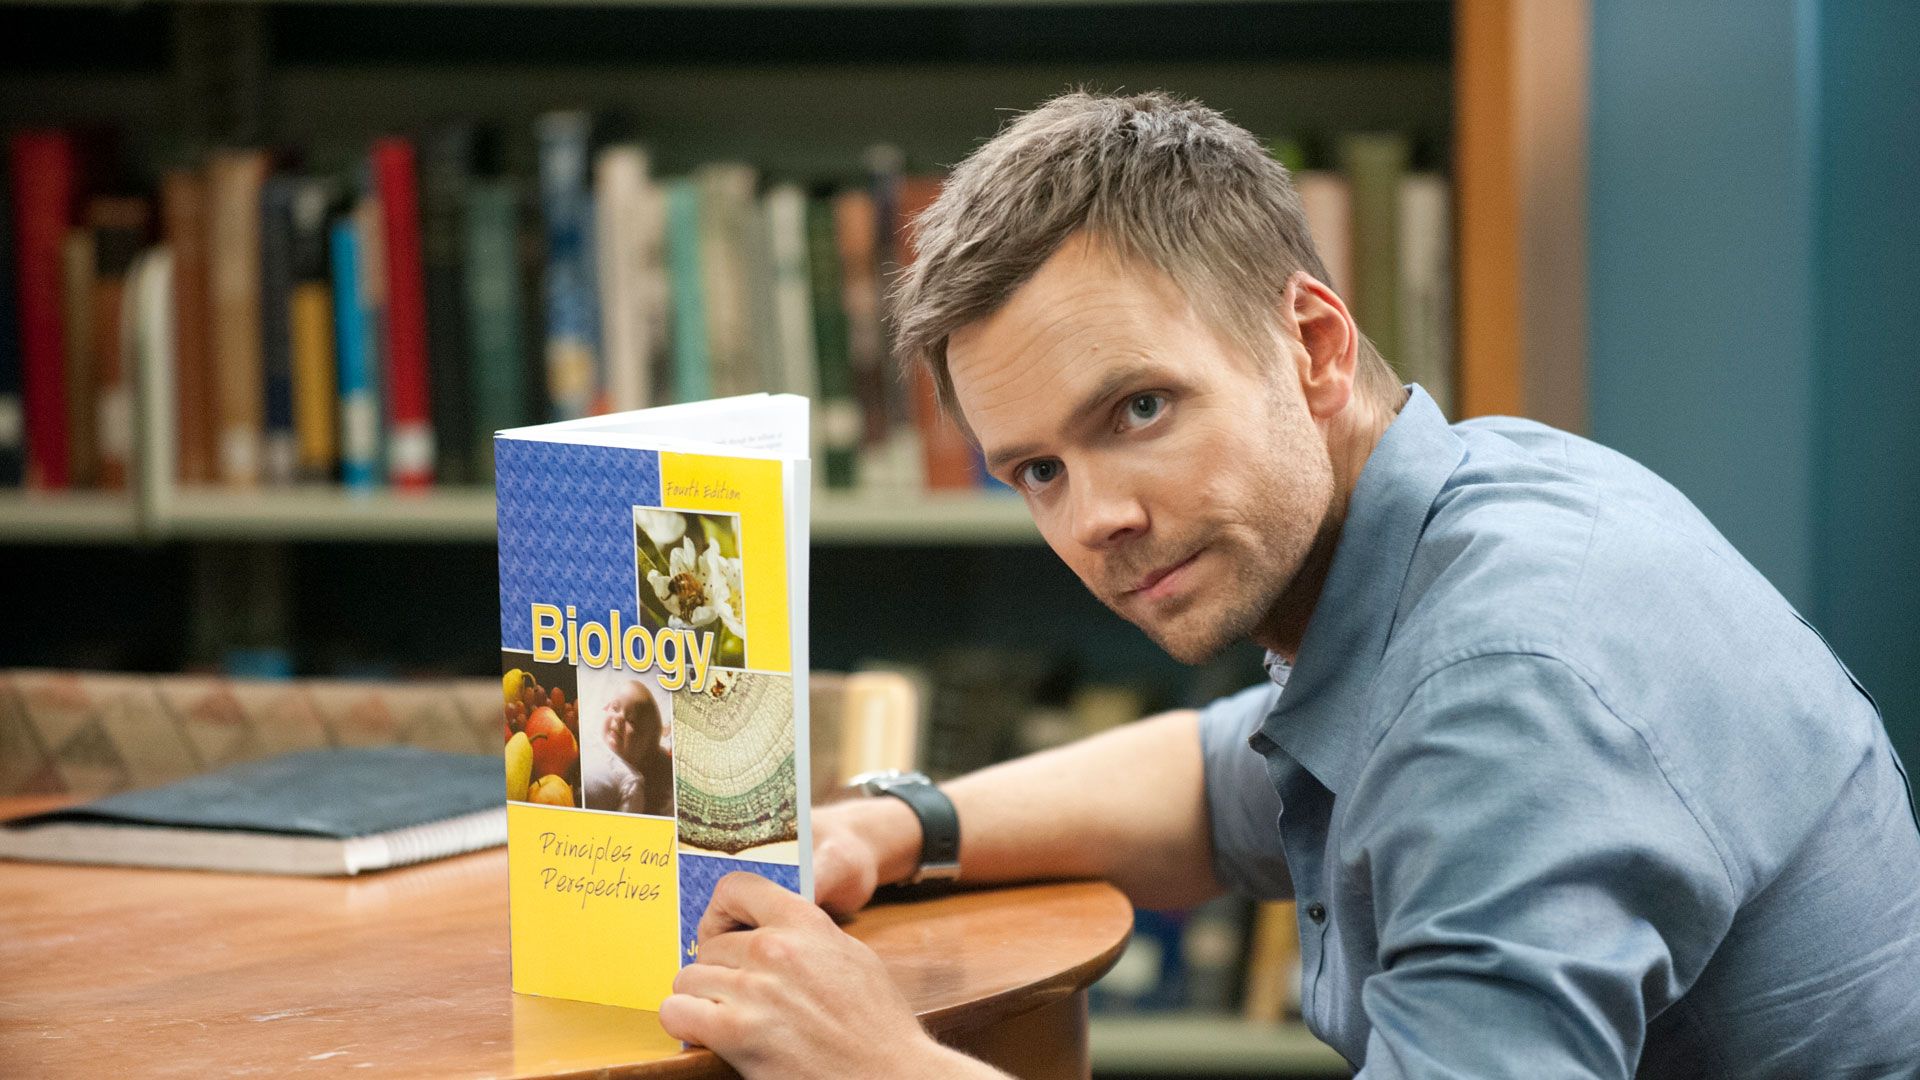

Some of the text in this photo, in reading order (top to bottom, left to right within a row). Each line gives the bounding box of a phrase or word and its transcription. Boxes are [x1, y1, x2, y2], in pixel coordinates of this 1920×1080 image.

[666, 478, 742, 500] Fourth Edition
[531, 602, 715, 693] Biology
[539, 831, 673, 875] Principles and
[540, 867, 660, 910] Perspectives
